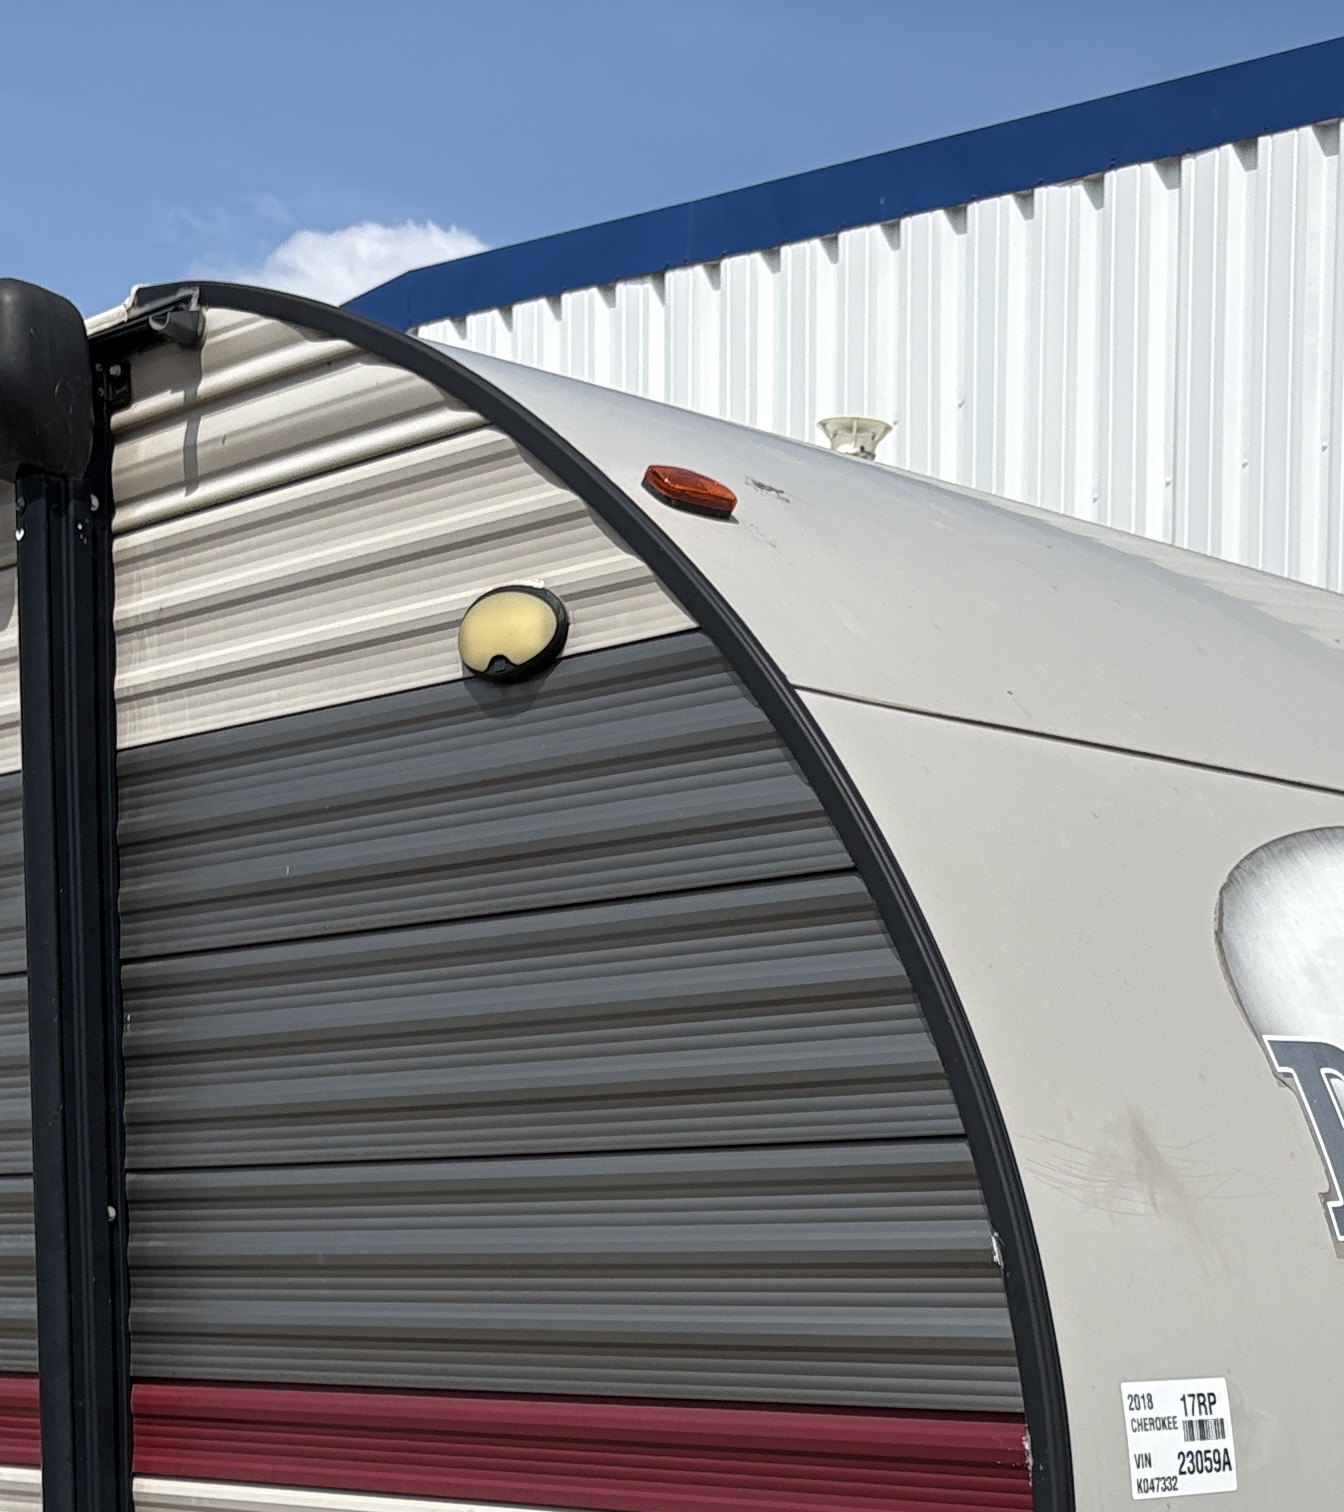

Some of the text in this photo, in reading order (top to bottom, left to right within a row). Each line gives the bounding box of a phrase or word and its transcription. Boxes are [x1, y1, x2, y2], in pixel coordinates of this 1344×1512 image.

[1127, 1393, 1154, 1411] 2018
[1180, 1392, 1217, 1417] 17RP
[1131, 1416, 1178, 1433] CHEROKEE
[1134, 1452, 1152, 1469] VIN
[1177, 1448, 1232, 1475] 23059A
